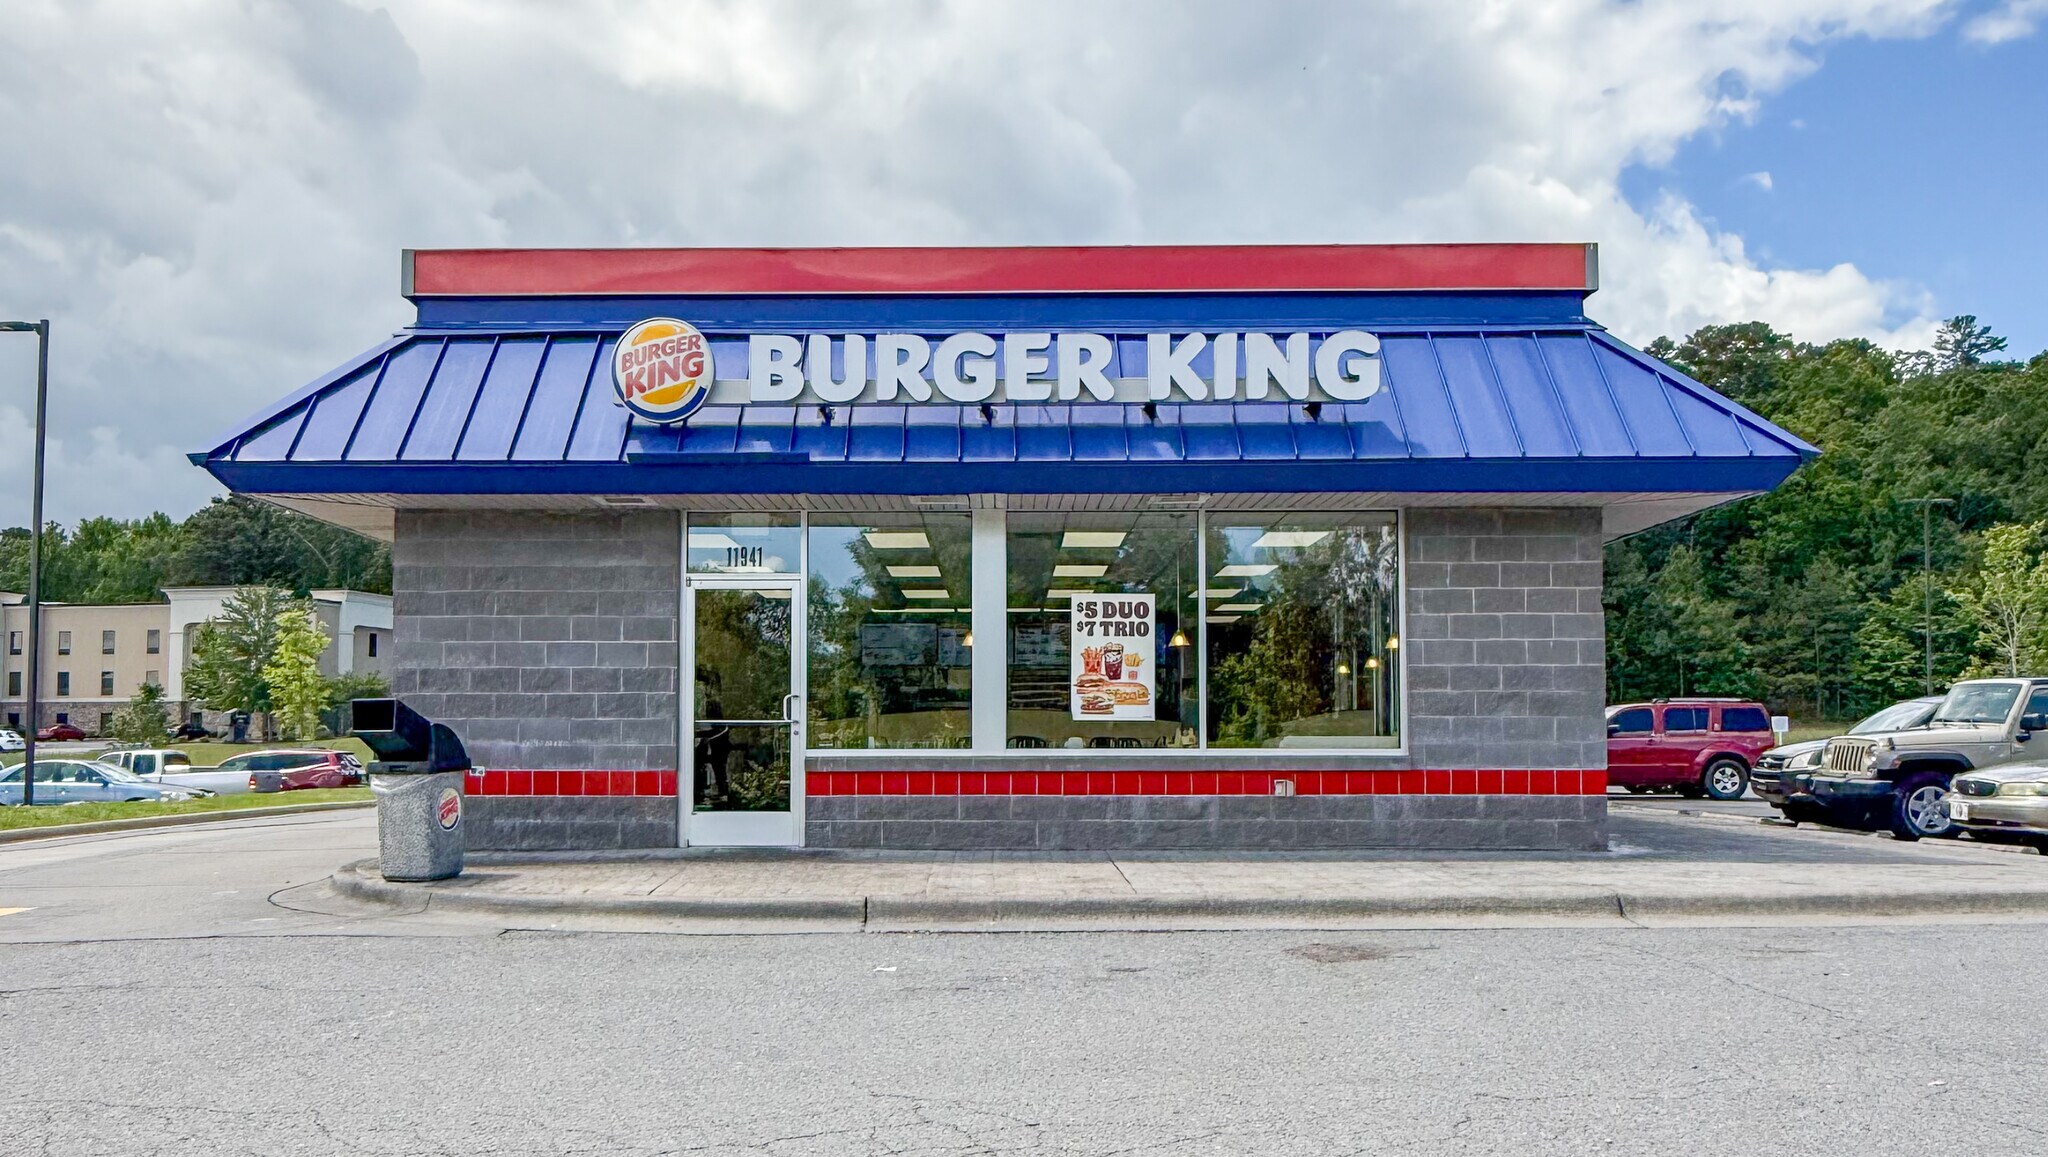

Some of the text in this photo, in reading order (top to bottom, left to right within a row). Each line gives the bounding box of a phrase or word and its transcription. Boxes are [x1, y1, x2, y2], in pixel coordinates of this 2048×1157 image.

[622, 334, 701, 373] BURGER
[750, 330, 1382, 402] BURGER KING
[625, 351, 705, 399] KING
[726, 546, 763, 567] 11941
[1076, 601, 1150, 619] $5 DUO
[1076, 620, 1150, 637] $7 TRIO
